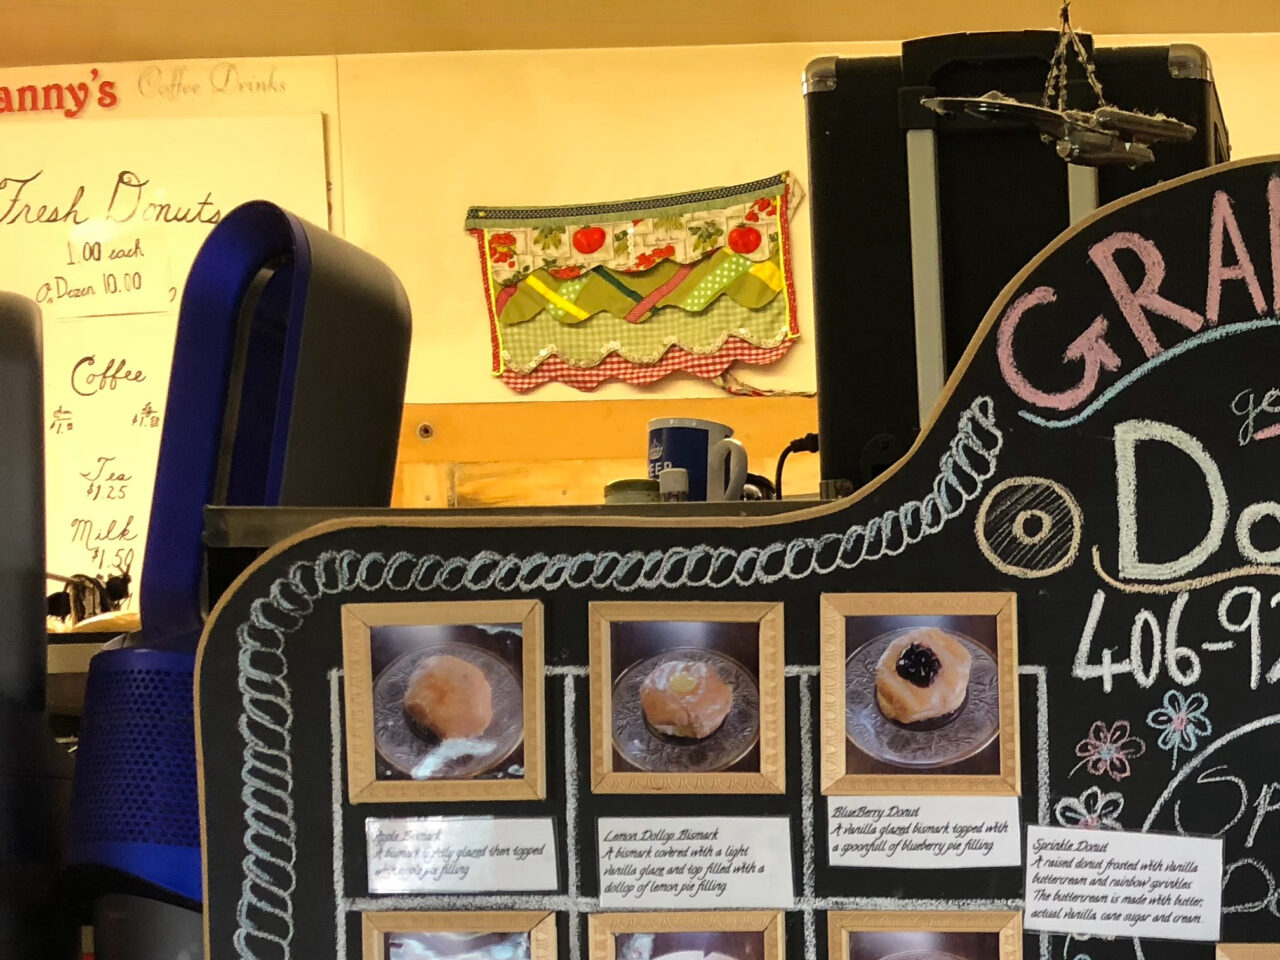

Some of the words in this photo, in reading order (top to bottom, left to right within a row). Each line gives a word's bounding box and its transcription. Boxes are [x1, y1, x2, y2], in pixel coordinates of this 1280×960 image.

[138, 64, 201, 102] Coffee
[0, 169, 89, 225] Fresh
[106, 170, 221, 225] Donuts
[108, 238, 144, 260] each
[55, 276, 96, 298] Dozen
[71, 355, 146, 396] Coffee
[80, 457, 132, 481] Tea
[87, 483, 128, 501] $1.25
[71, 515, 137, 550] Milk
